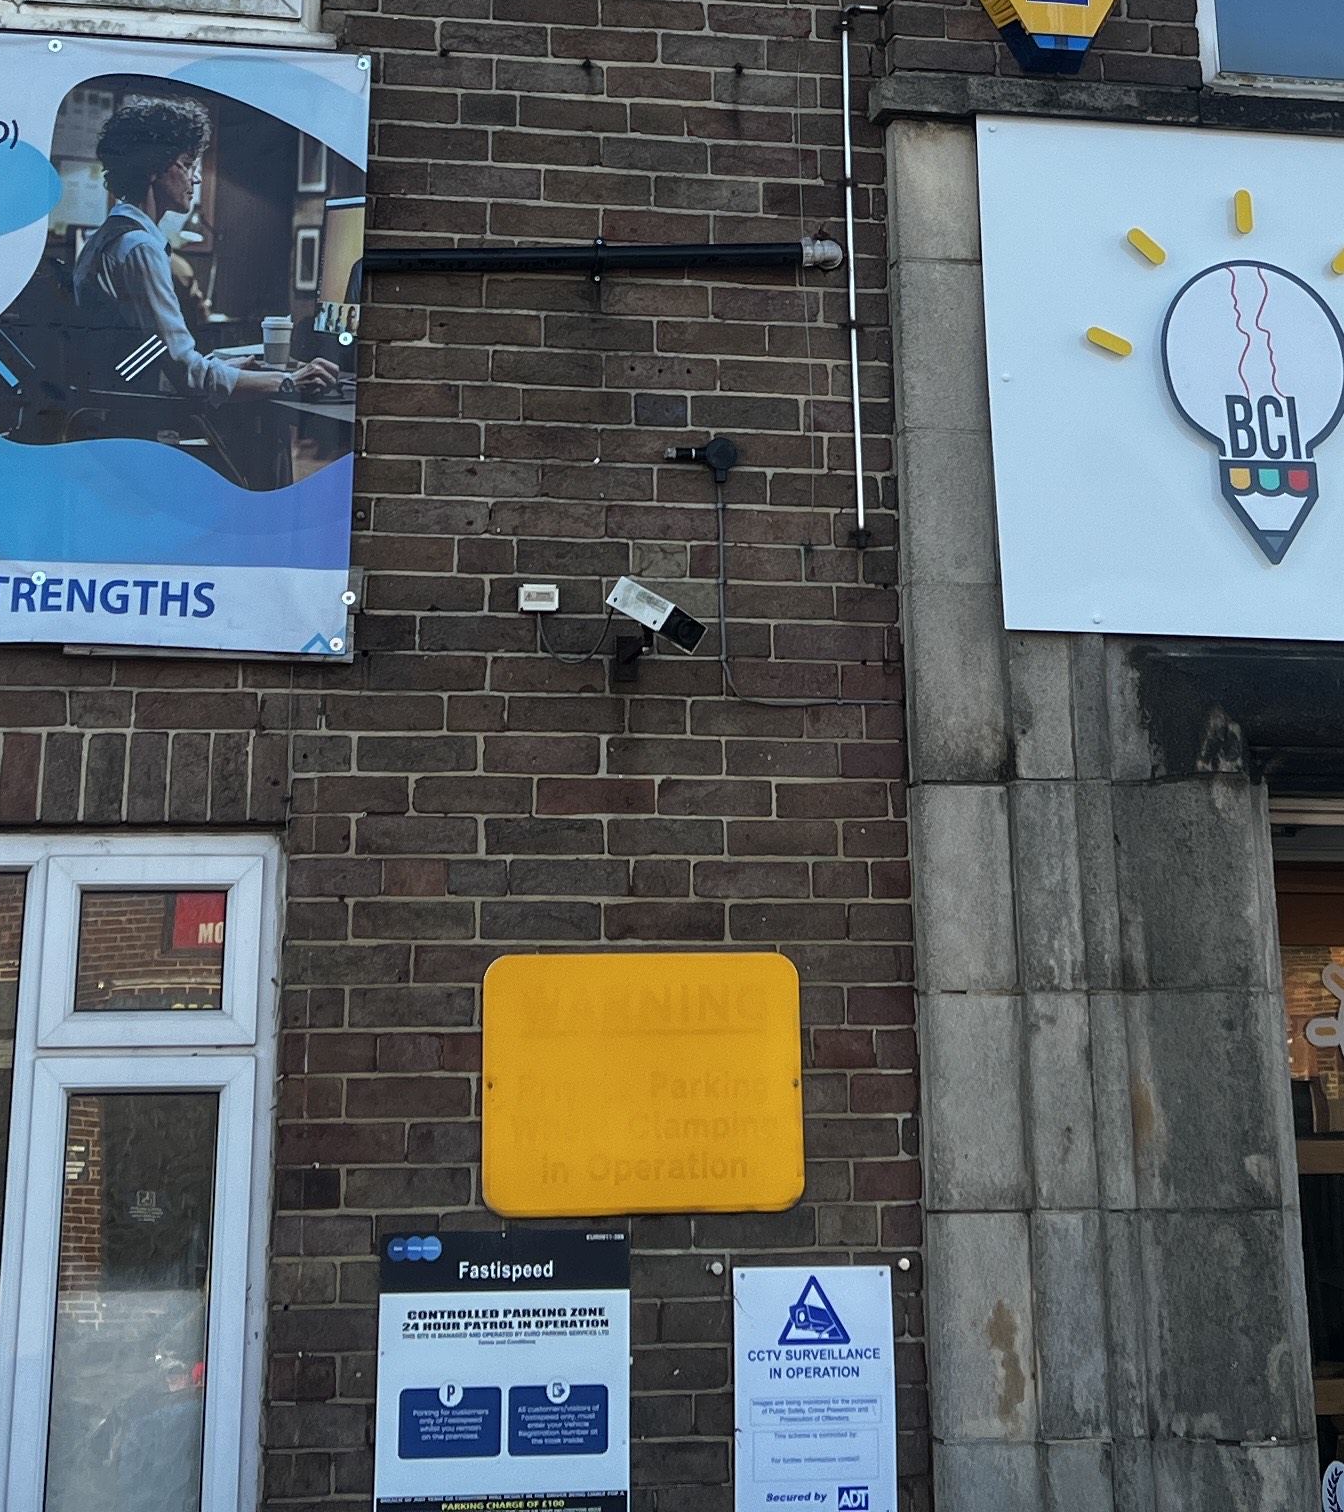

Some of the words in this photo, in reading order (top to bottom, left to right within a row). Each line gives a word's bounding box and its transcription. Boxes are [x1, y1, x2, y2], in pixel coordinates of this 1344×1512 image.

[1224, 394, 1303, 460] BCI
[587, 1152, 748, 1186] Operation
[459, 1260, 554, 1282] Fastispeed
[407, 1309, 499, 1320] CONTROLLED
[503, 1307, 567, 1319] PARKING
[570, 1306, 605, 1317] ZONE
[402, 1322, 419, 1332] 24
[423, 1322, 461, 1331] HOUR
[464, 1320, 514, 1330] PATROL
[517, 1320, 532, 1329] IN
[535, 1319, 609, 1329] OPERATION
[747, 1349, 782, 1362] CCTV
[785, 1348, 881, 1361] SURVEILLANCE
[769, 1367, 782, 1379] IN
[785, 1366, 860, 1379] OPERATION
[766, 1491, 811, 1503] Secured
[814, 1491, 828, 1503] by
[838, 1489, 869, 1509] ADT
[441, 1501, 484, 1511] PARKING
[486, 1500, 525, 1509] CHARGE
[526, 1500, 539, 1508] OF
